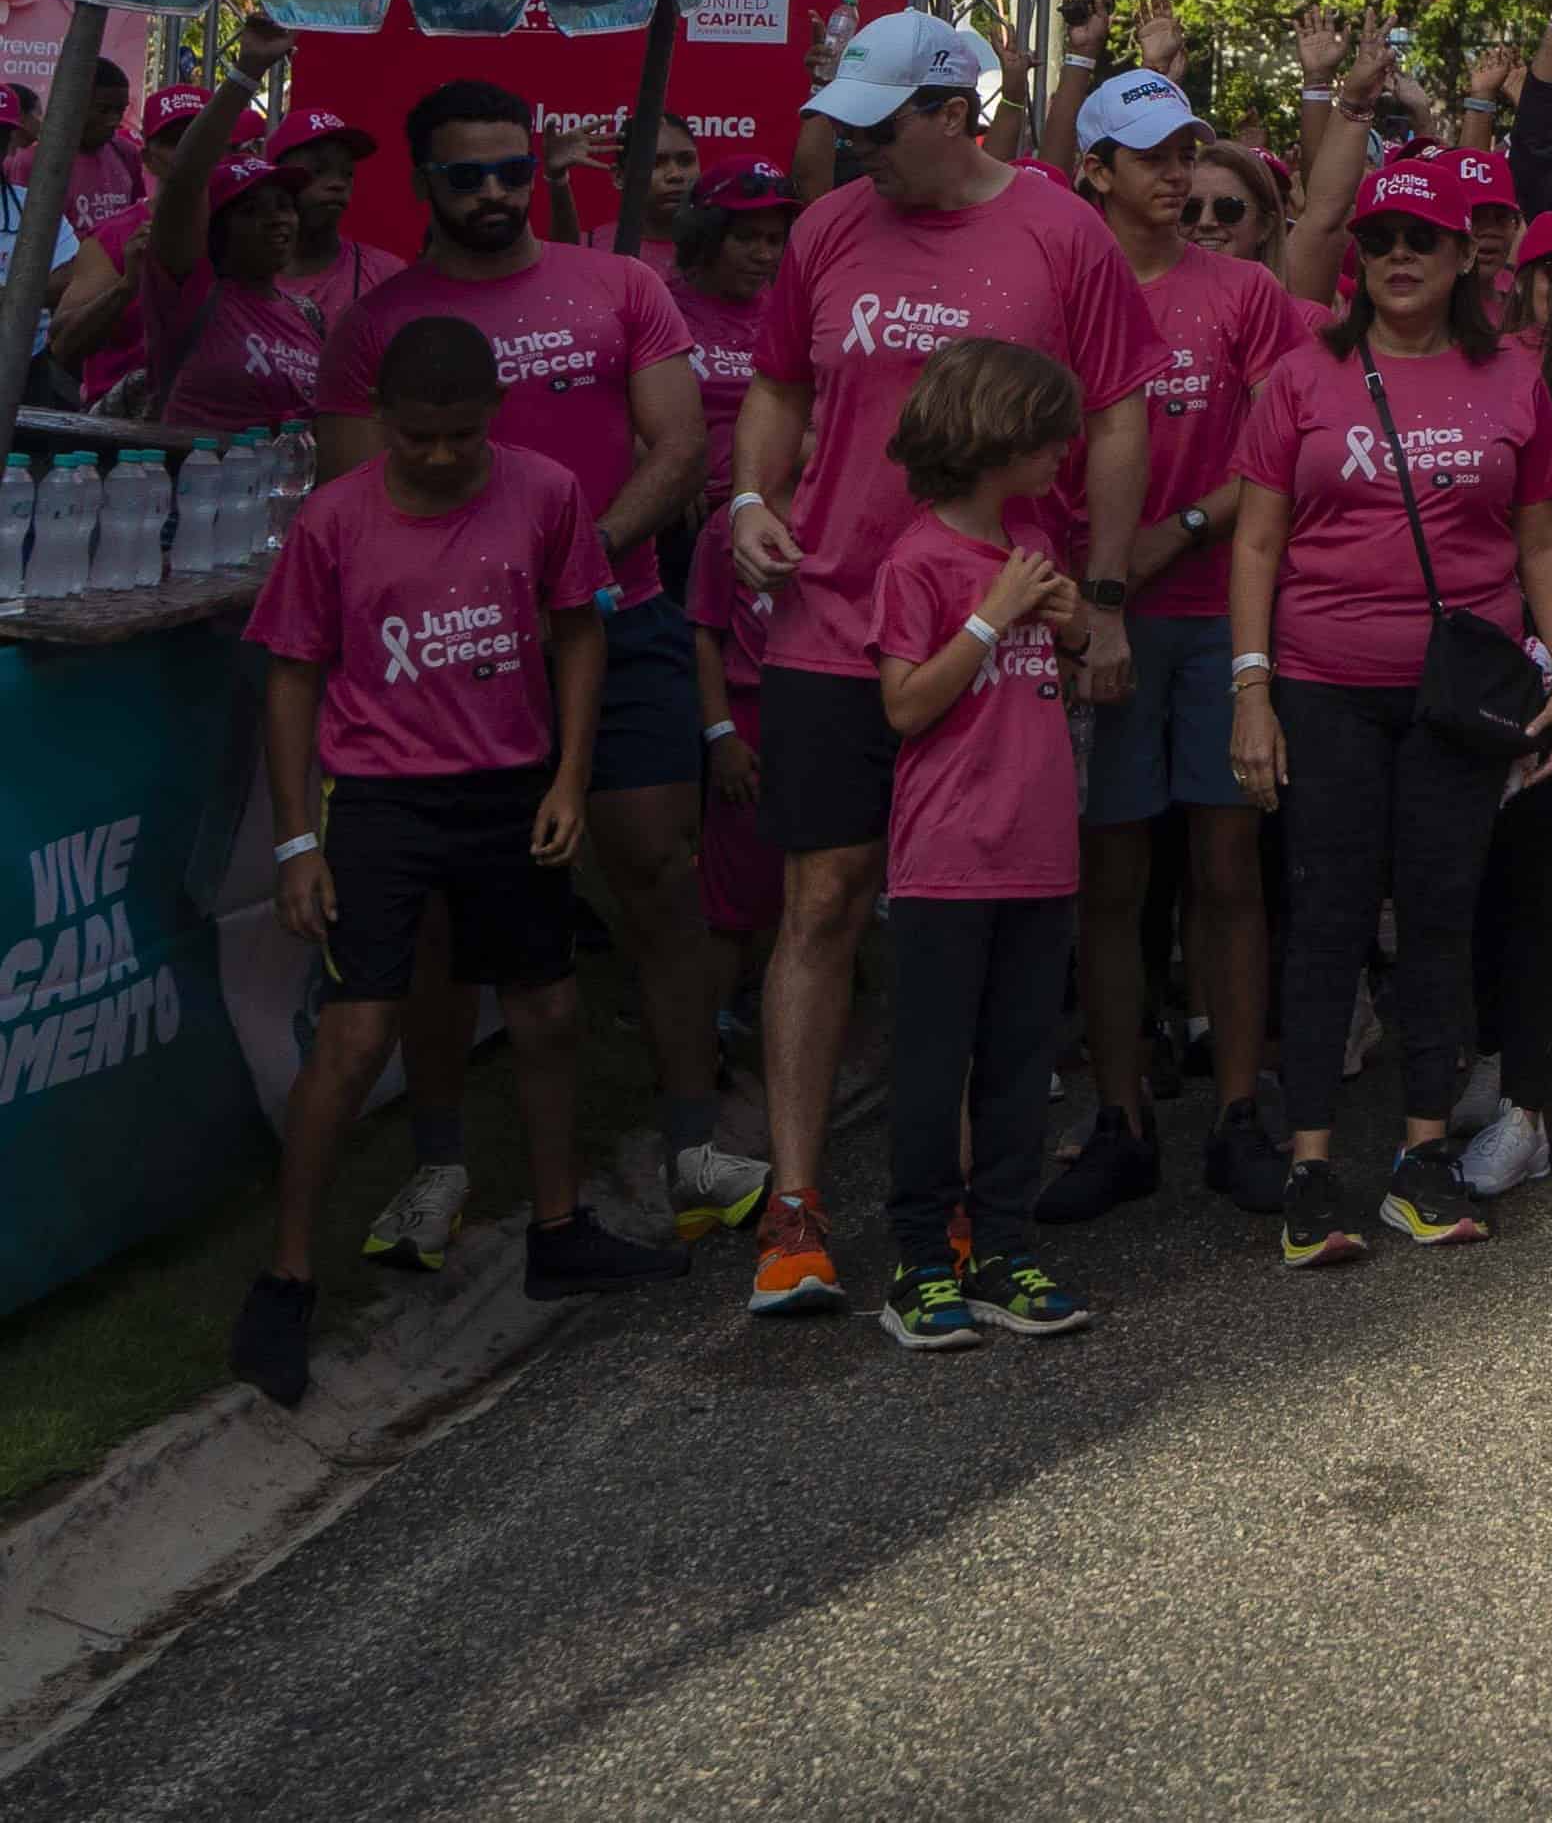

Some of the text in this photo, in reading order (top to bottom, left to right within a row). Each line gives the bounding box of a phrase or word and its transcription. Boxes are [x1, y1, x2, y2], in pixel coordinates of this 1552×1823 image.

[697, 11, 779, 28] CAPITAL
[1388, 172, 1429, 188] Juntos
[1460, 157, 1493, 184] GC
[1388, 184, 1437, 201] Crecer
[884, 294, 970, 328] Juntos
[494, 328, 574, 360] Juntos
[497, 350, 597, 385] Crecer
[1144, 373, 1211, 399] recer
[413, 603, 502, 642] Juntos
[30, 815, 140, 927] VIVE
[0, 964, 180, 1105] MENTO
